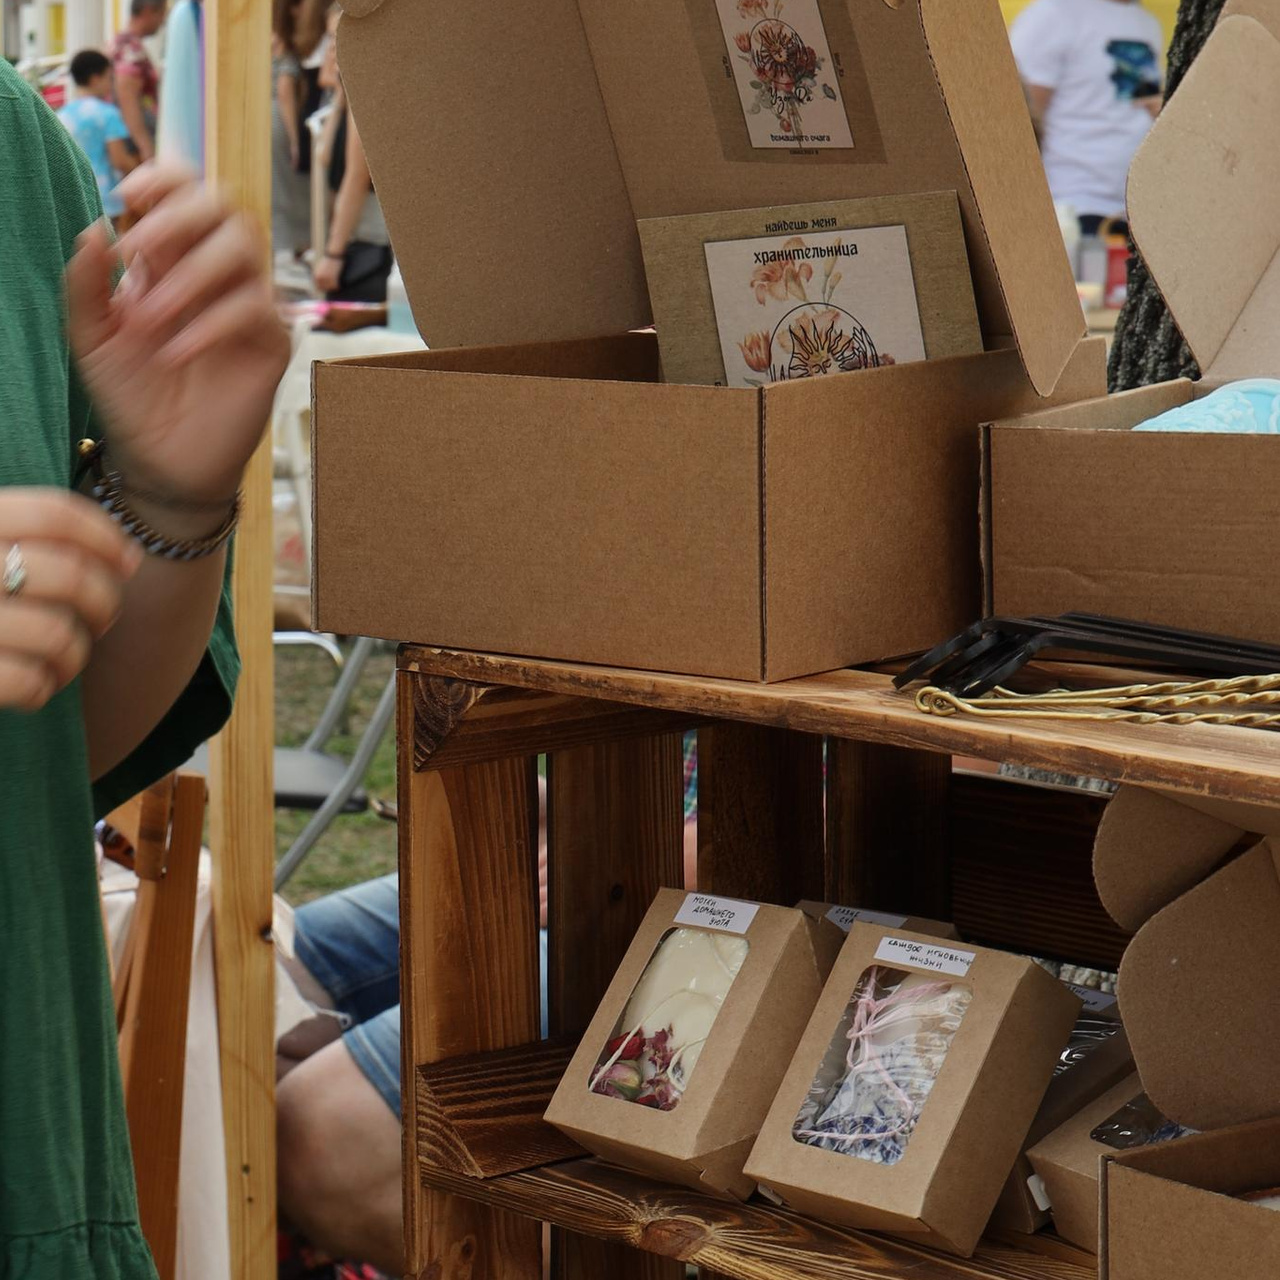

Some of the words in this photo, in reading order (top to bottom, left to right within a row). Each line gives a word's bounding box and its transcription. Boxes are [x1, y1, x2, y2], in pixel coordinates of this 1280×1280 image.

[765, 220, 809, 233] найдешь
[811, 217, 837, 228] меня
[753, 243, 859, 265] хранительница
